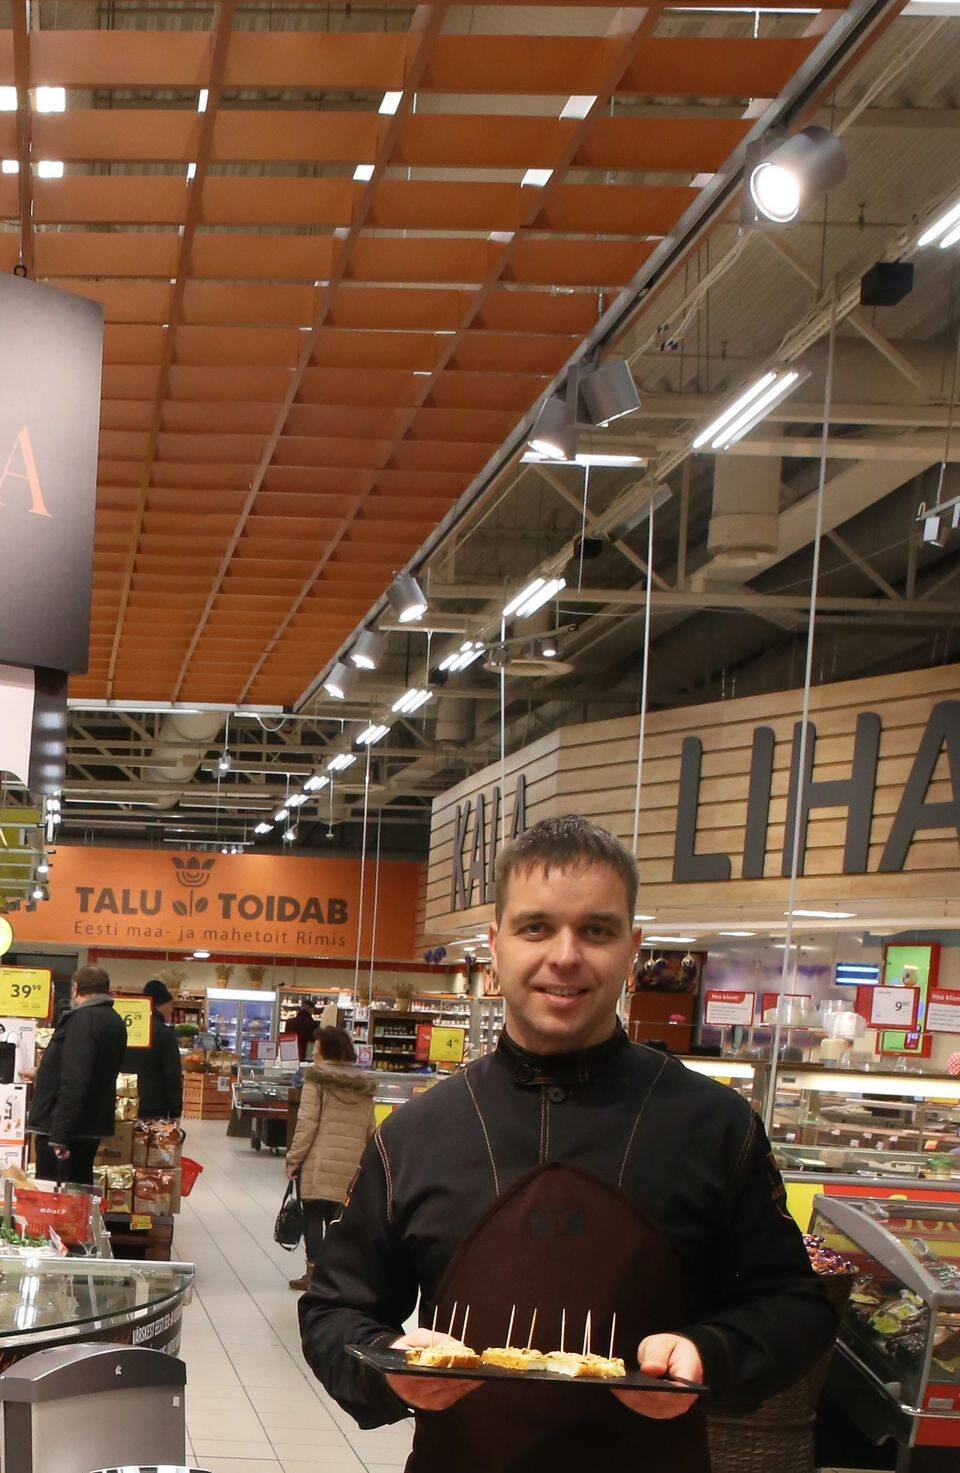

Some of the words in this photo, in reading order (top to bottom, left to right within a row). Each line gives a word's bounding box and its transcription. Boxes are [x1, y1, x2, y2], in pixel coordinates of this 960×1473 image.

[672, 701, 960, 882] LIHA
[75, 886, 162, 916] TALU
[218, 893, 348, 925] TOIDAB
[74, 921, 118, 936] Eesti
[127, 925, 171, 939] maa-
[178, 924, 194, 941] ja
[204, 927, 288, 945] mahetoit
[296, 931, 346, 947] Rimis
